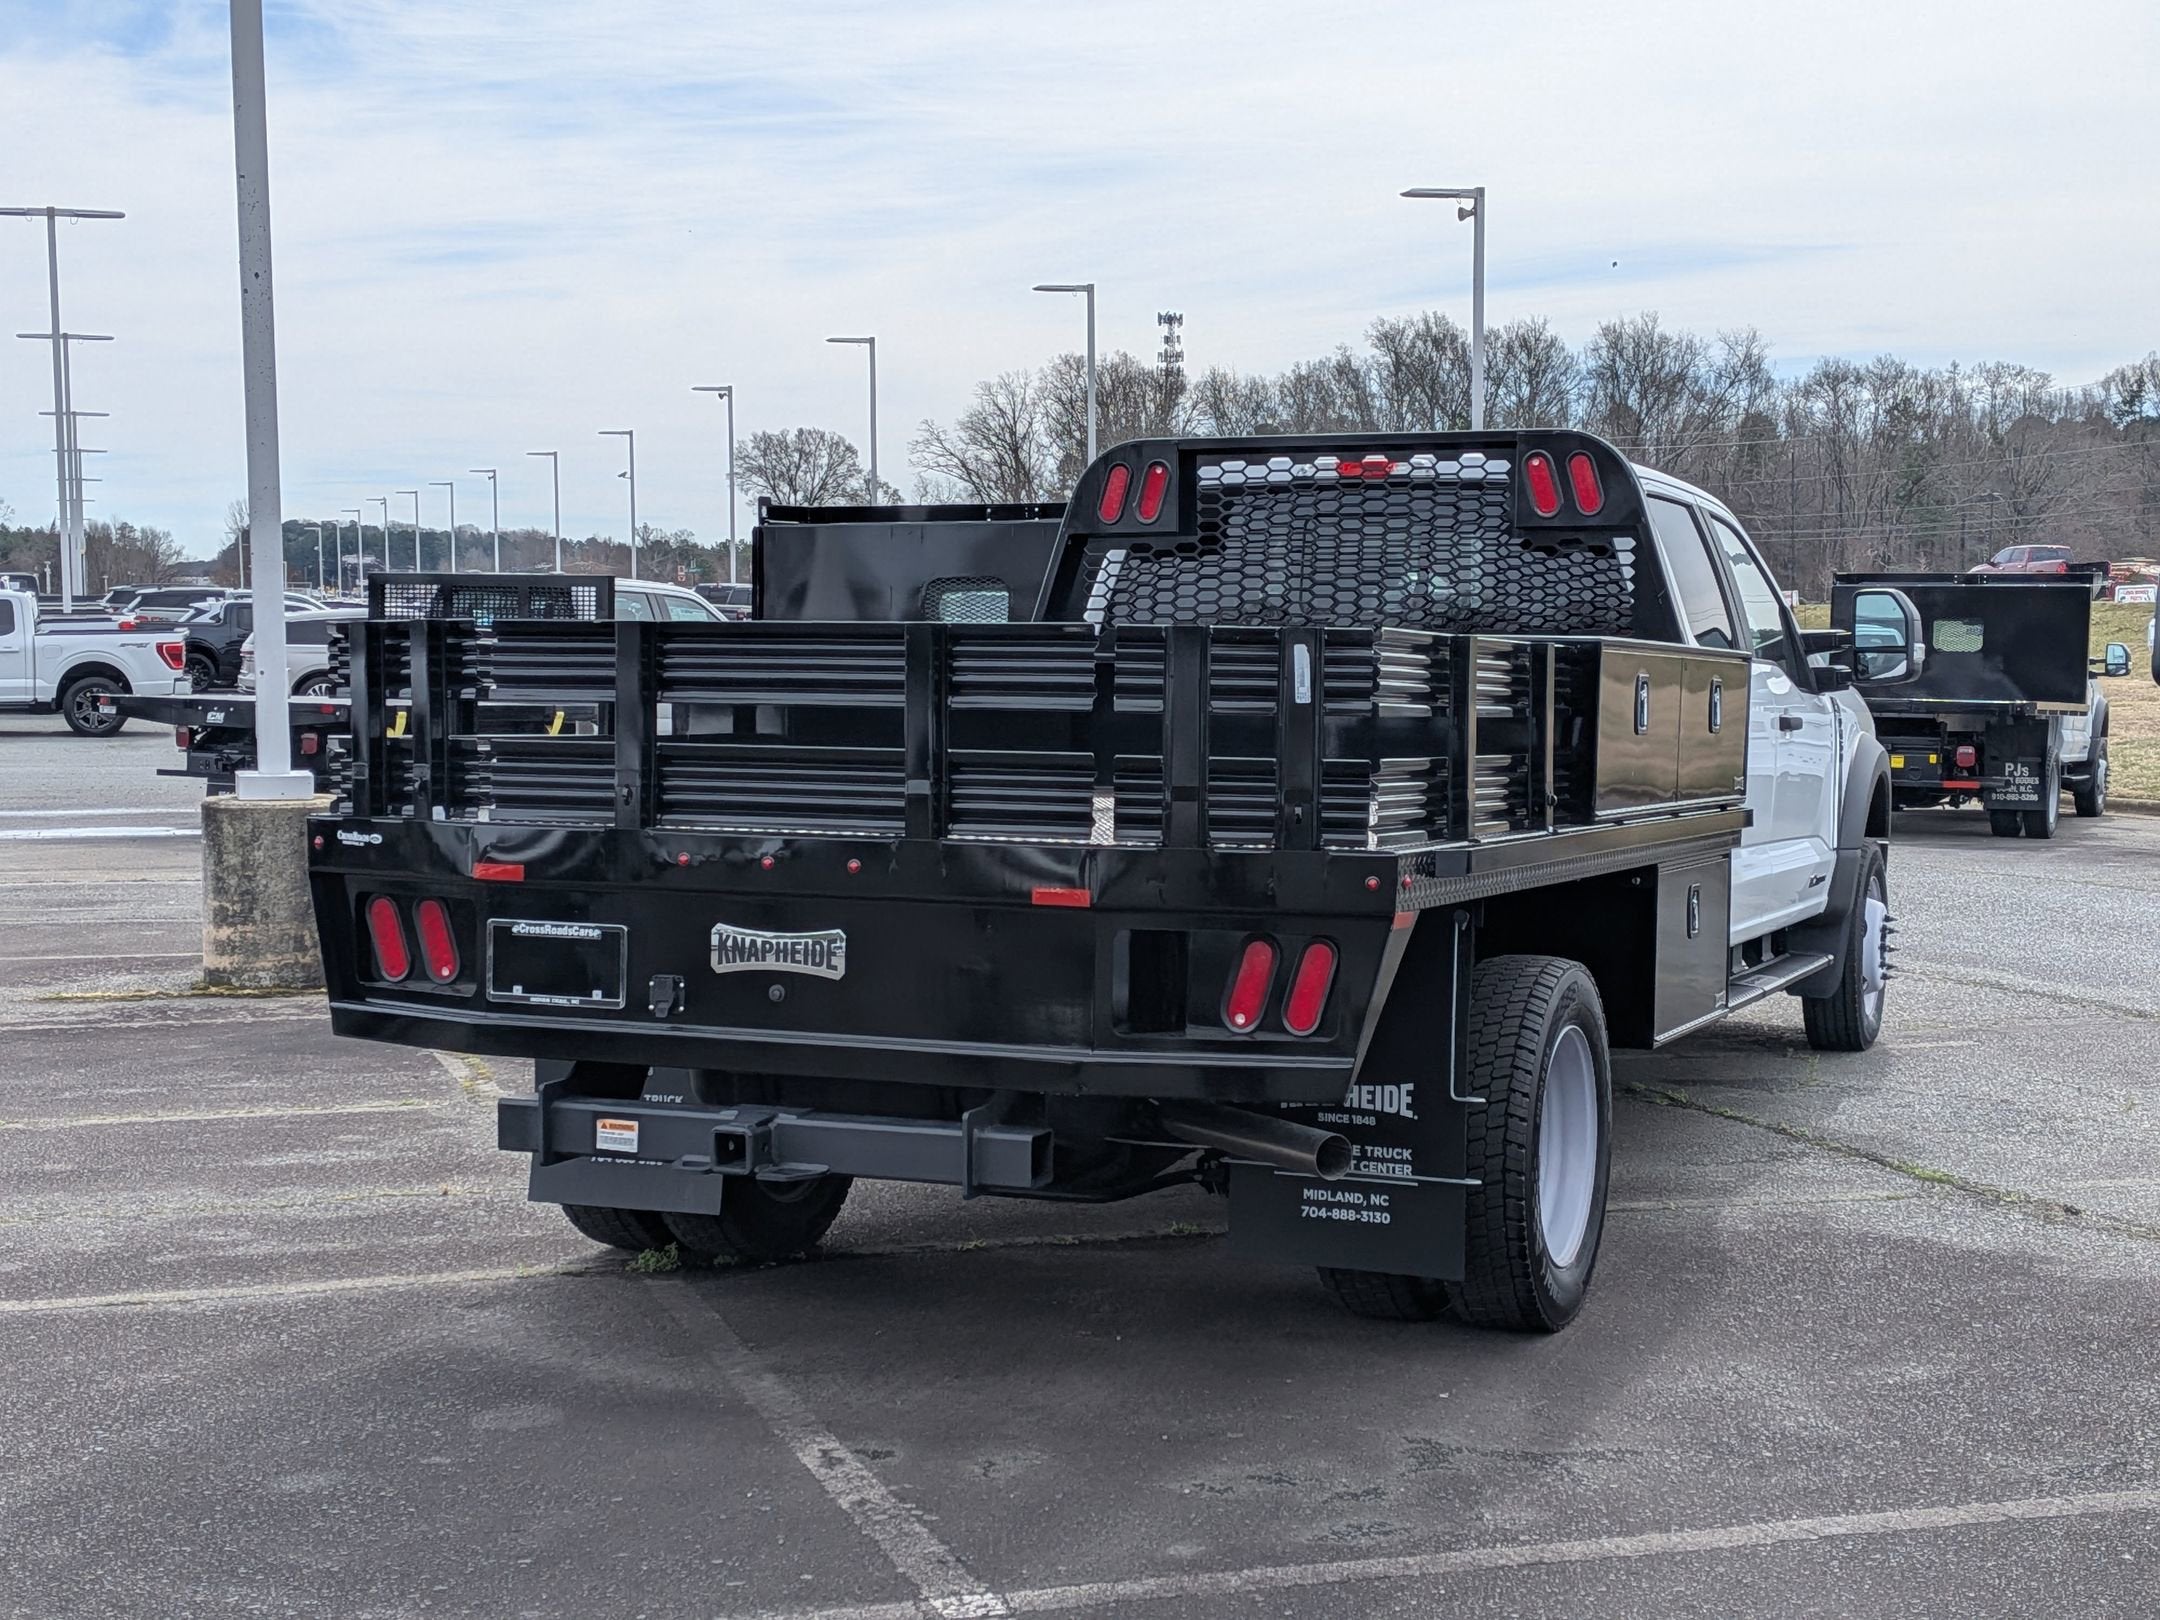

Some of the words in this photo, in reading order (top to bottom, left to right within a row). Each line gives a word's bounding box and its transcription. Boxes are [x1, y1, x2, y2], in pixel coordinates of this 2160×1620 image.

[717, 931, 839, 971] KNAPHEIDE
[1318, 1112, 1350, 1123] SINCE
[1351, 1115, 1376, 1126] 1848
[1365, 1146, 1412, 1160] TRUCK
[1360, 1161, 1412, 1176] CENTER
[1303, 1188, 1367, 1207] MIDLAND,
[1370, 1194, 1389, 1207] NC
[1301, 1206, 1390, 1224] 704-888-3130
